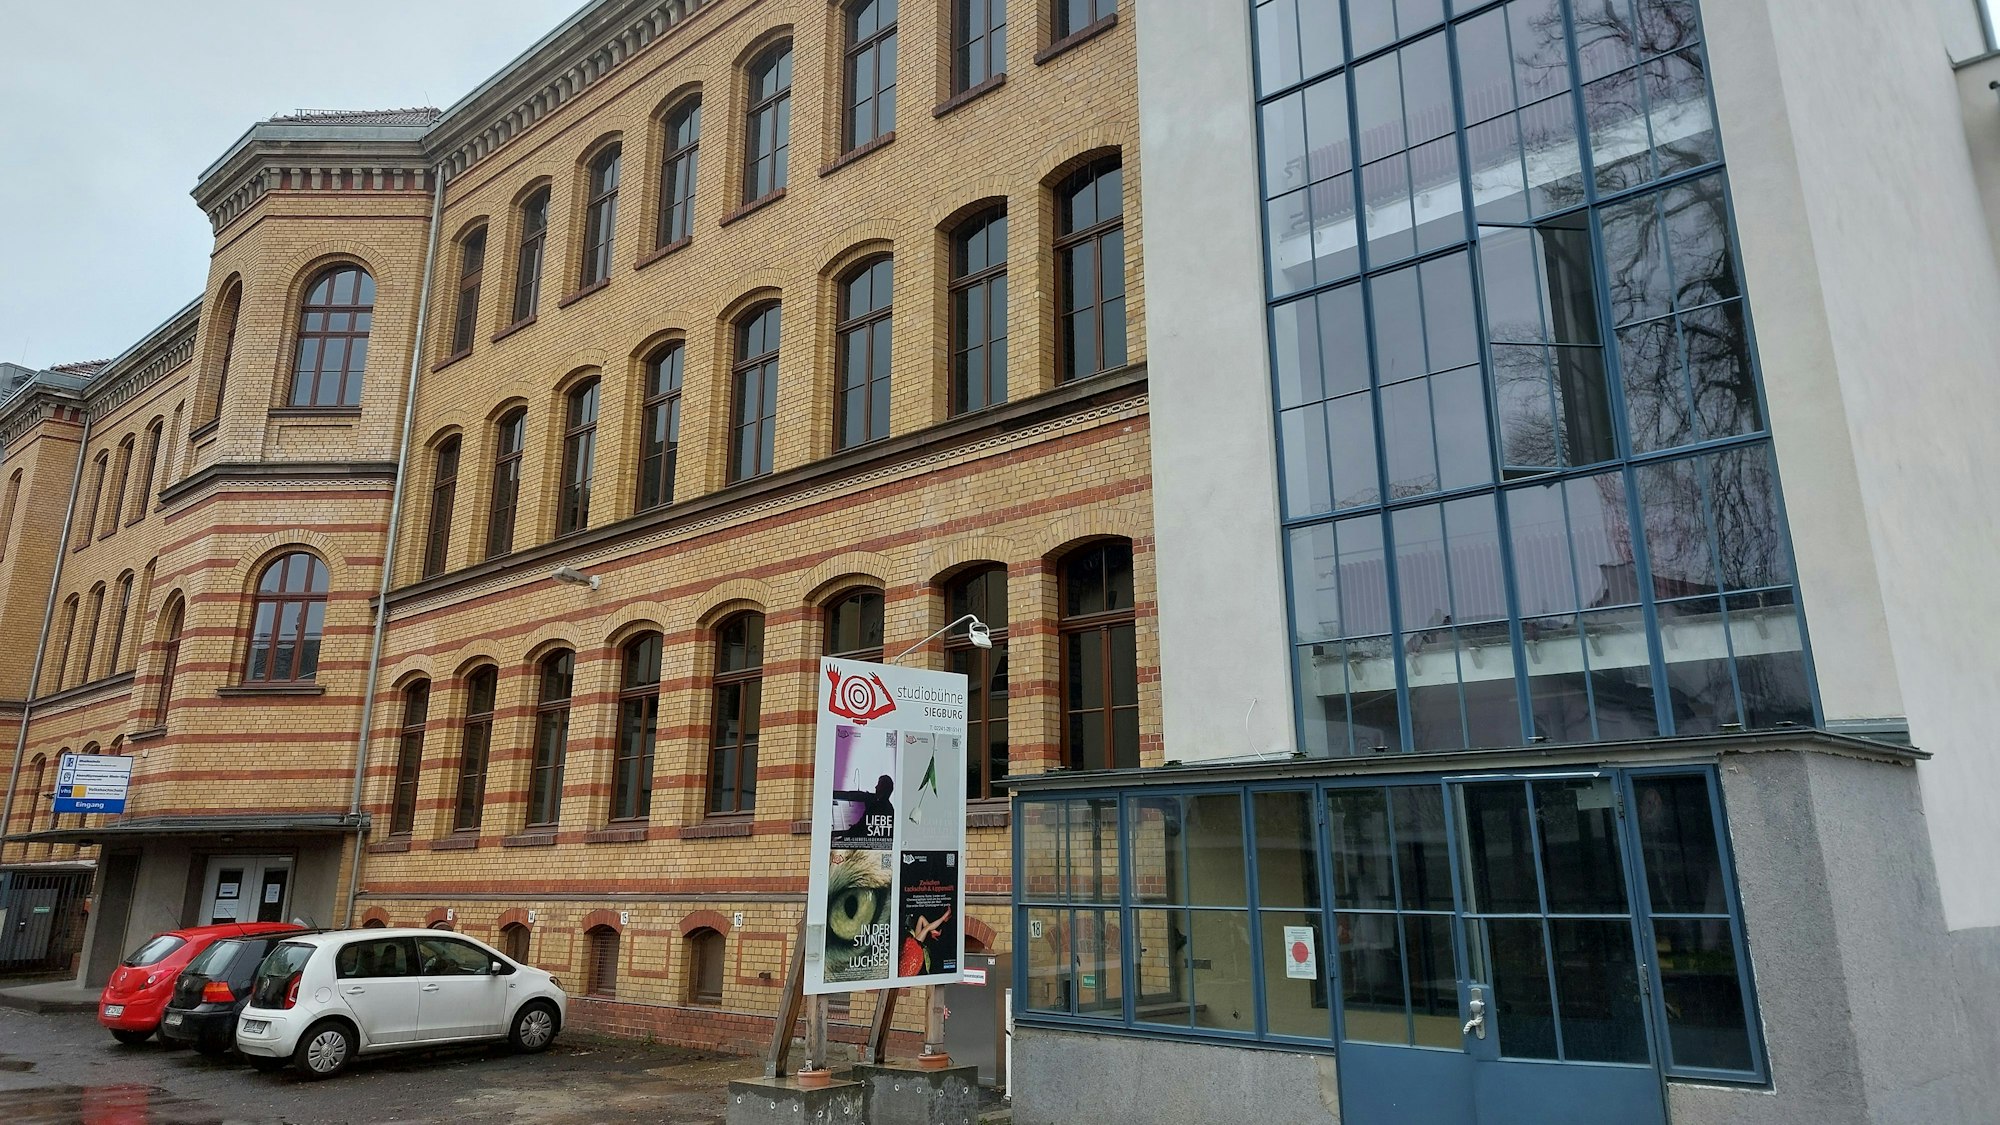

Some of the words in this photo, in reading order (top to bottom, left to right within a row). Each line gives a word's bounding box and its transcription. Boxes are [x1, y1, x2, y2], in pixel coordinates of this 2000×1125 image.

[897, 685, 963, 704] studiobühne
[924, 707, 963, 719] SIEGBURG
[865, 814, 892, 827] LIEBE
[867, 826, 892, 837] SATT
[736, 914, 741, 925] 16
[861, 924, 870, 935] IN
[872, 924, 889, 935] DER
[1032, 922, 1040, 936] 18
[853, 935, 889, 946] STUNDE
[872, 945, 889, 956] DES
[849, 955, 889, 968] LUCHSES
